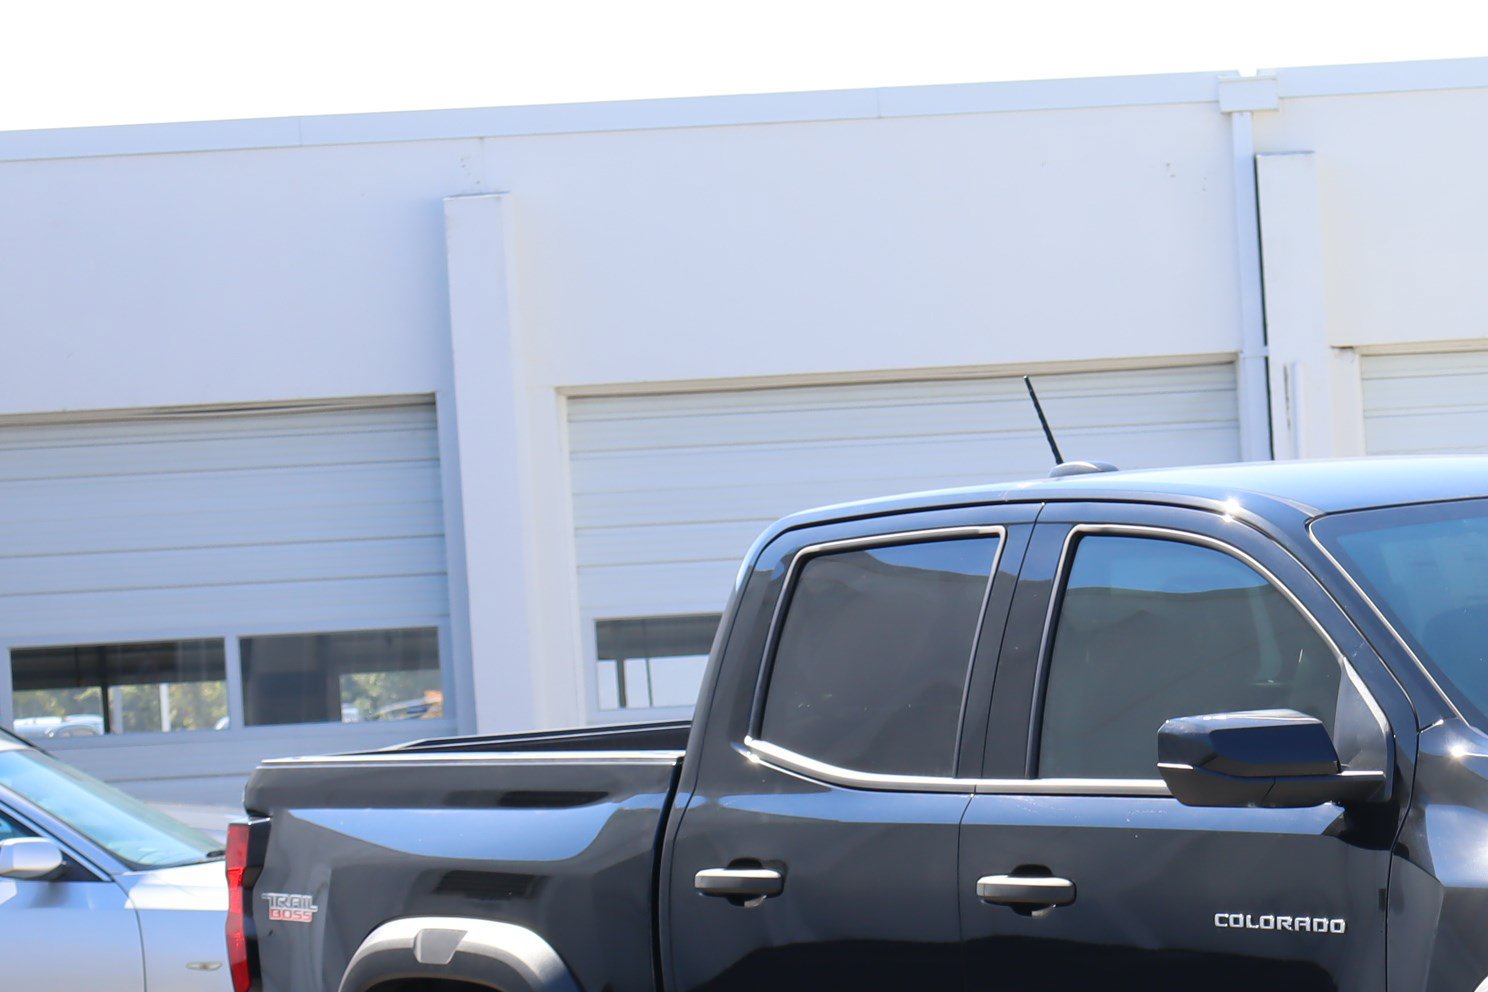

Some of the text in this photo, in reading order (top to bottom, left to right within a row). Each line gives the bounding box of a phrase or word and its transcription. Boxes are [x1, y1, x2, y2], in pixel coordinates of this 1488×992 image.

[261, 892, 318, 912] TRAIL
[269, 909, 312, 922] BOSS
[1214, 912, 1346, 934] COLORADO
